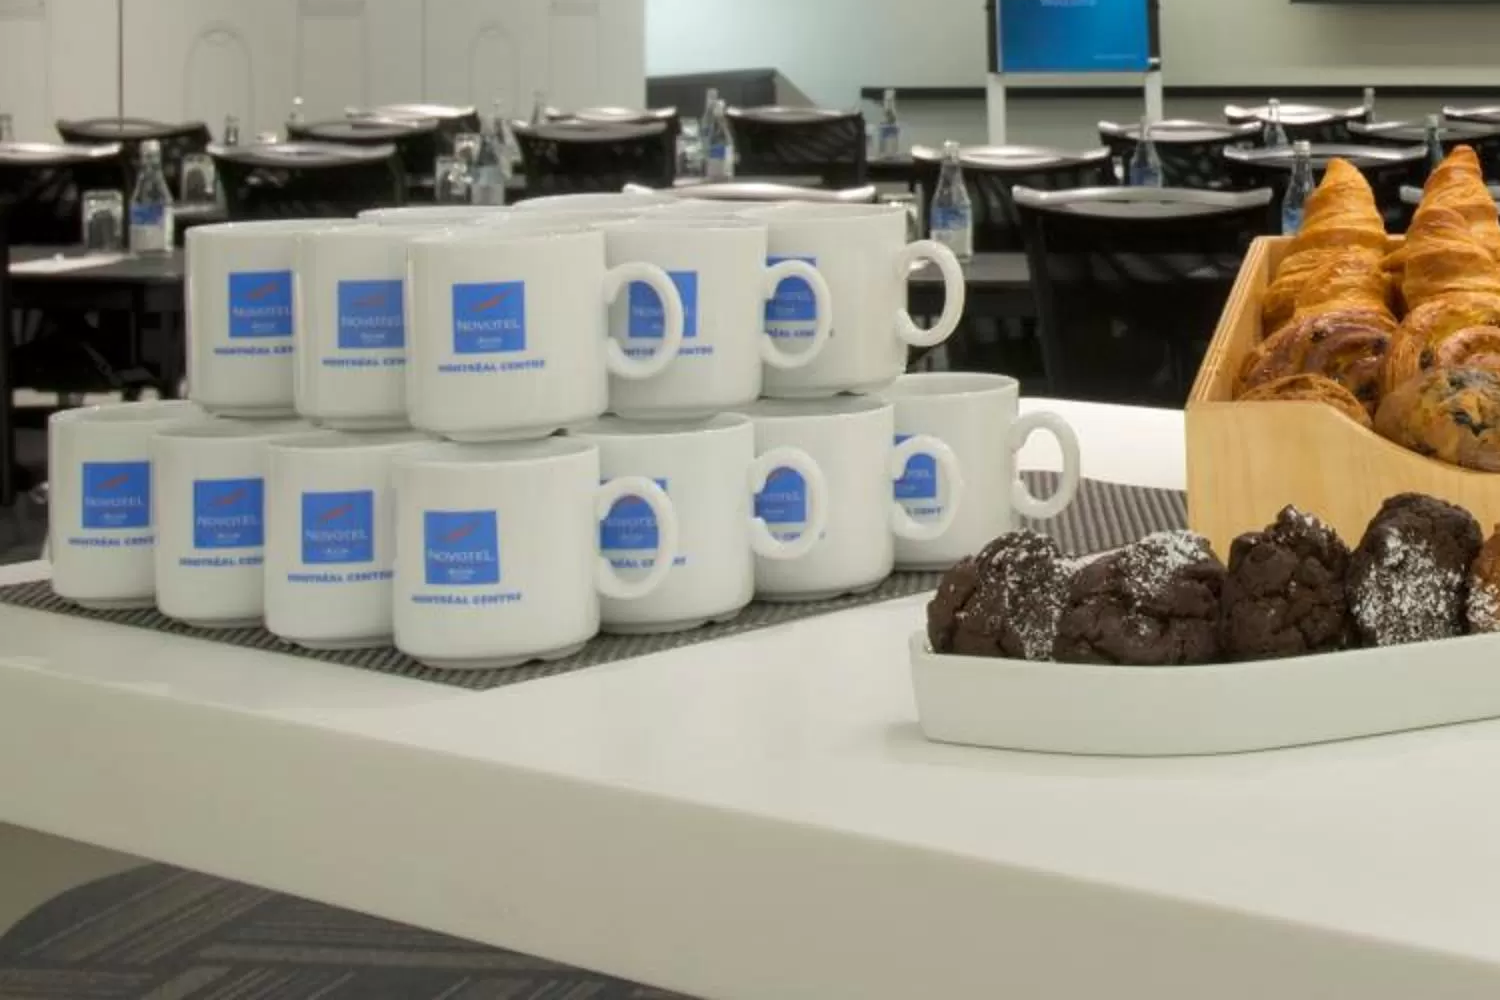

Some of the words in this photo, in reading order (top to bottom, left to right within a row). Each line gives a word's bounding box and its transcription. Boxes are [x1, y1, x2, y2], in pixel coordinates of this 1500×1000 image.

[456, 319, 520, 332] NOVOTEL
[437, 361, 497, 374] MONTRÉAL
[501, 359, 546, 371] CENTRE
[84, 495, 144, 507] NOVOTEL
[197, 515, 258, 528] NOVOTEL
[304, 528, 369, 542] NOVOTEL
[427, 548, 496, 562] NOVOTEL
[410, 593, 469, 606] MONTRÉAL
[471, 592, 523, 606] CENTRE
